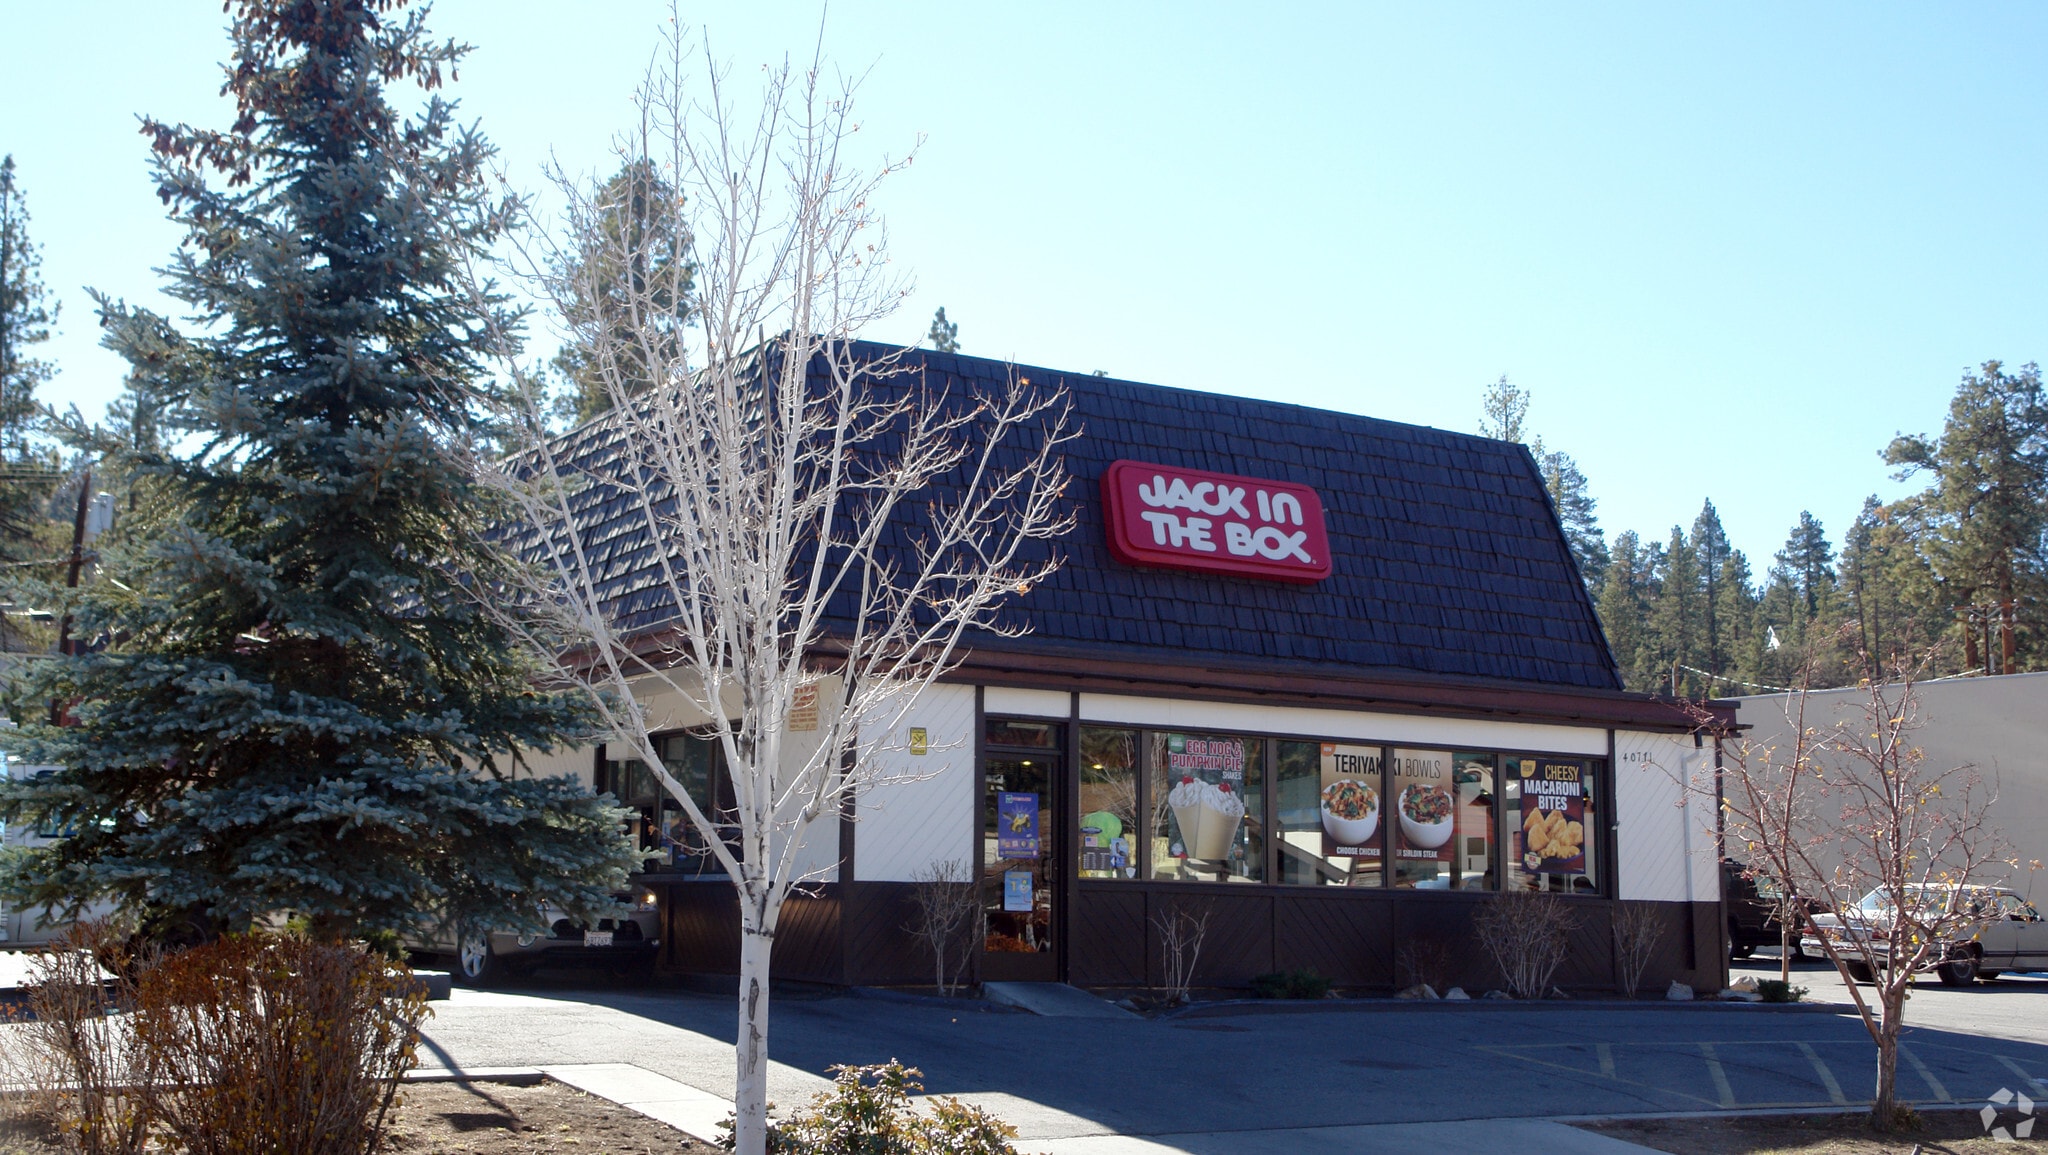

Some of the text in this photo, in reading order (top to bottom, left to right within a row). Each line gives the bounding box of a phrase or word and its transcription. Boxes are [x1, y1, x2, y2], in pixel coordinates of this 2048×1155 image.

[1138, 475, 1250, 519] JACK
[1140, 511, 1311, 564] THE BOX
[1186, 740, 1207, 755] EGG
[1209, 741, 1232, 756] NOG
[1234, 743, 1242, 757] &
[1171, 754, 1242, 771] PUMPKIN PIE
[1406, 758, 1441, 779] BOWLS
[1222, 770, 1242, 780] SHAKES
[1544, 764, 1579, 782] CHEESY
[1524, 780, 1580, 796] MACARONI
[1538, 796, 1568, 810] BITES
[1336, 846, 1358, 855] CHOOSE
